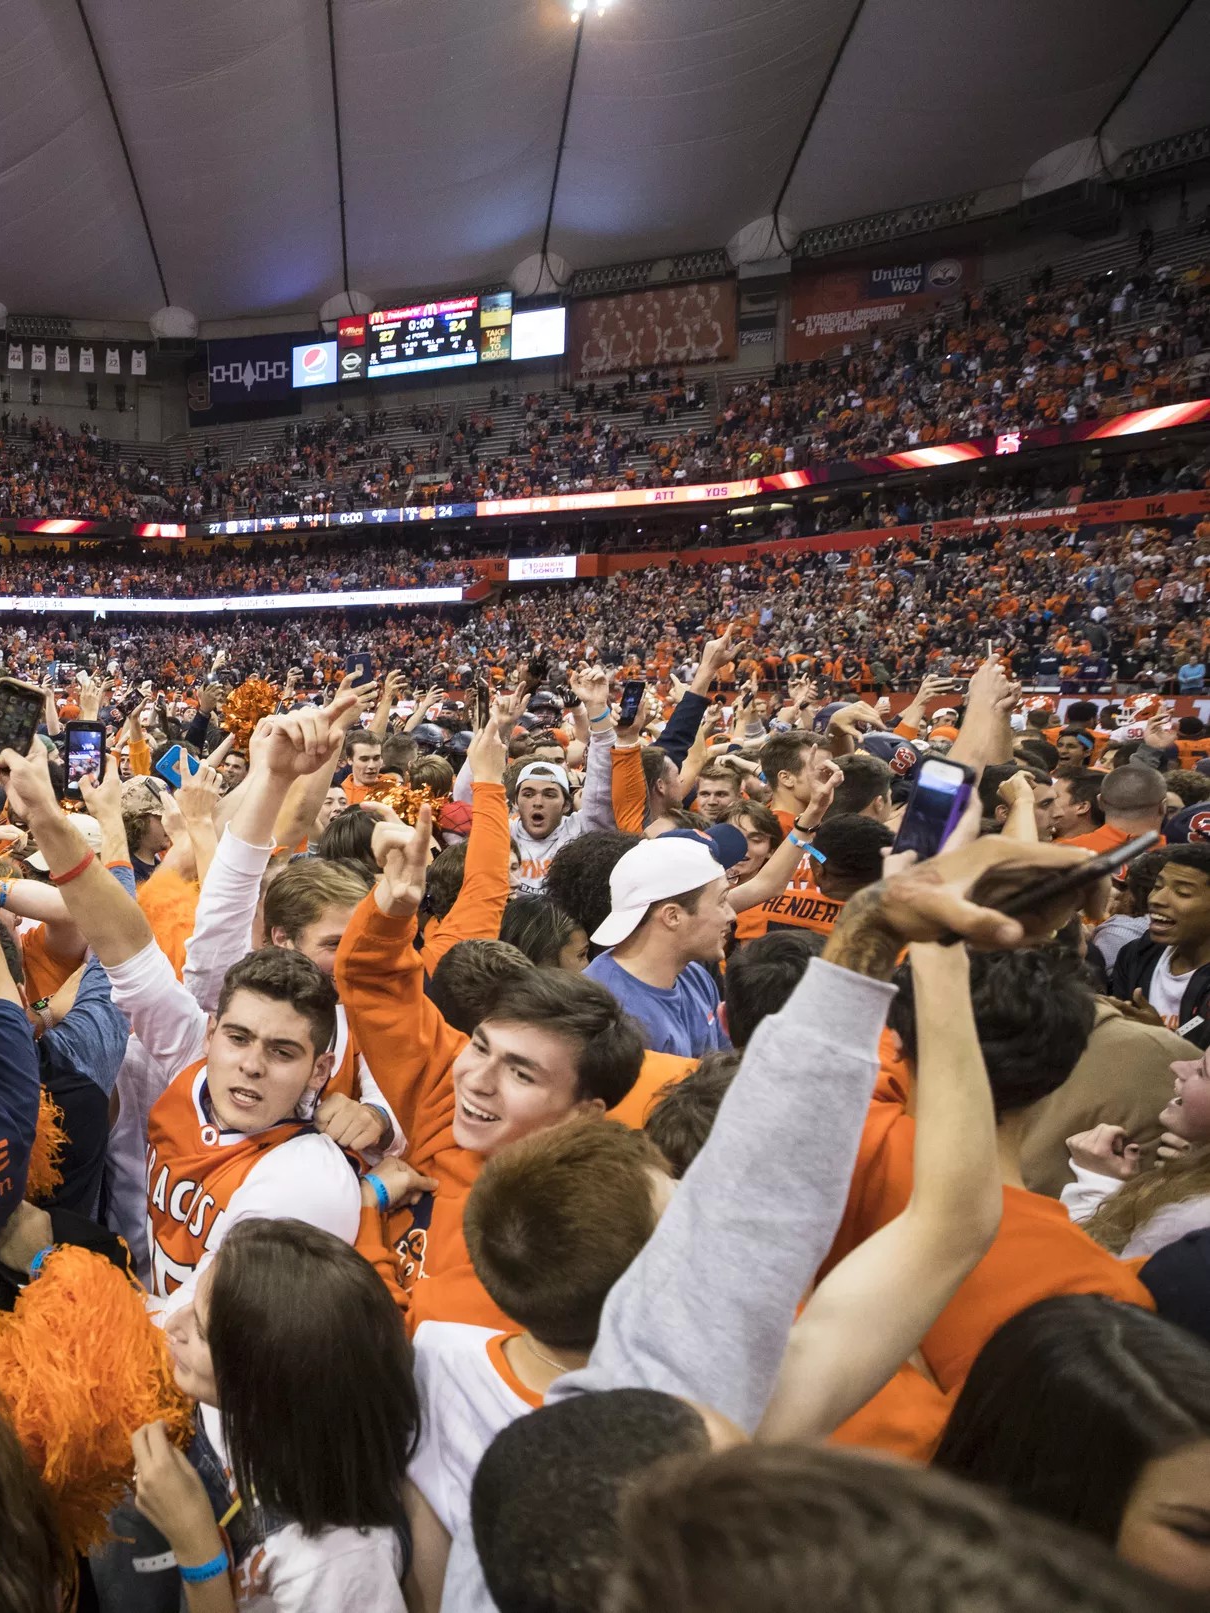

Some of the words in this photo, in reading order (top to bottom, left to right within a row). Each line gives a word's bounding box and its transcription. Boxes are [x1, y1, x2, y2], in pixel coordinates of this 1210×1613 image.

[872, 264, 921, 282] United
[890, 278, 921, 293] Way
[408, 318, 434, 331] 0:00
[449, 318, 466, 332] 24
[379, 330, 395, 343] 27
[485, 328, 506, 338] TAKE
[489, 337, 501, 345] ME
[481, 349, 509, 360] CROUSE
[655, 490, 675, 501] ATT
[706, 487, 728, 498] YDS
[439, 506, 452, 517] 24
[1019, 510, 1052, 520] COLLEGE
[1055, 506, 1078, 516] TEAM
[1146, 503, 1165, 516] 114
[340, 512, 364, 524] 0:00
[209, 524, 221, 534] 27
[919, 524, 934, 541] S
[28, 600, 49, 608] CUSE
[52, 600, 64, 608] 44
[889, 747, 917, 776] S
